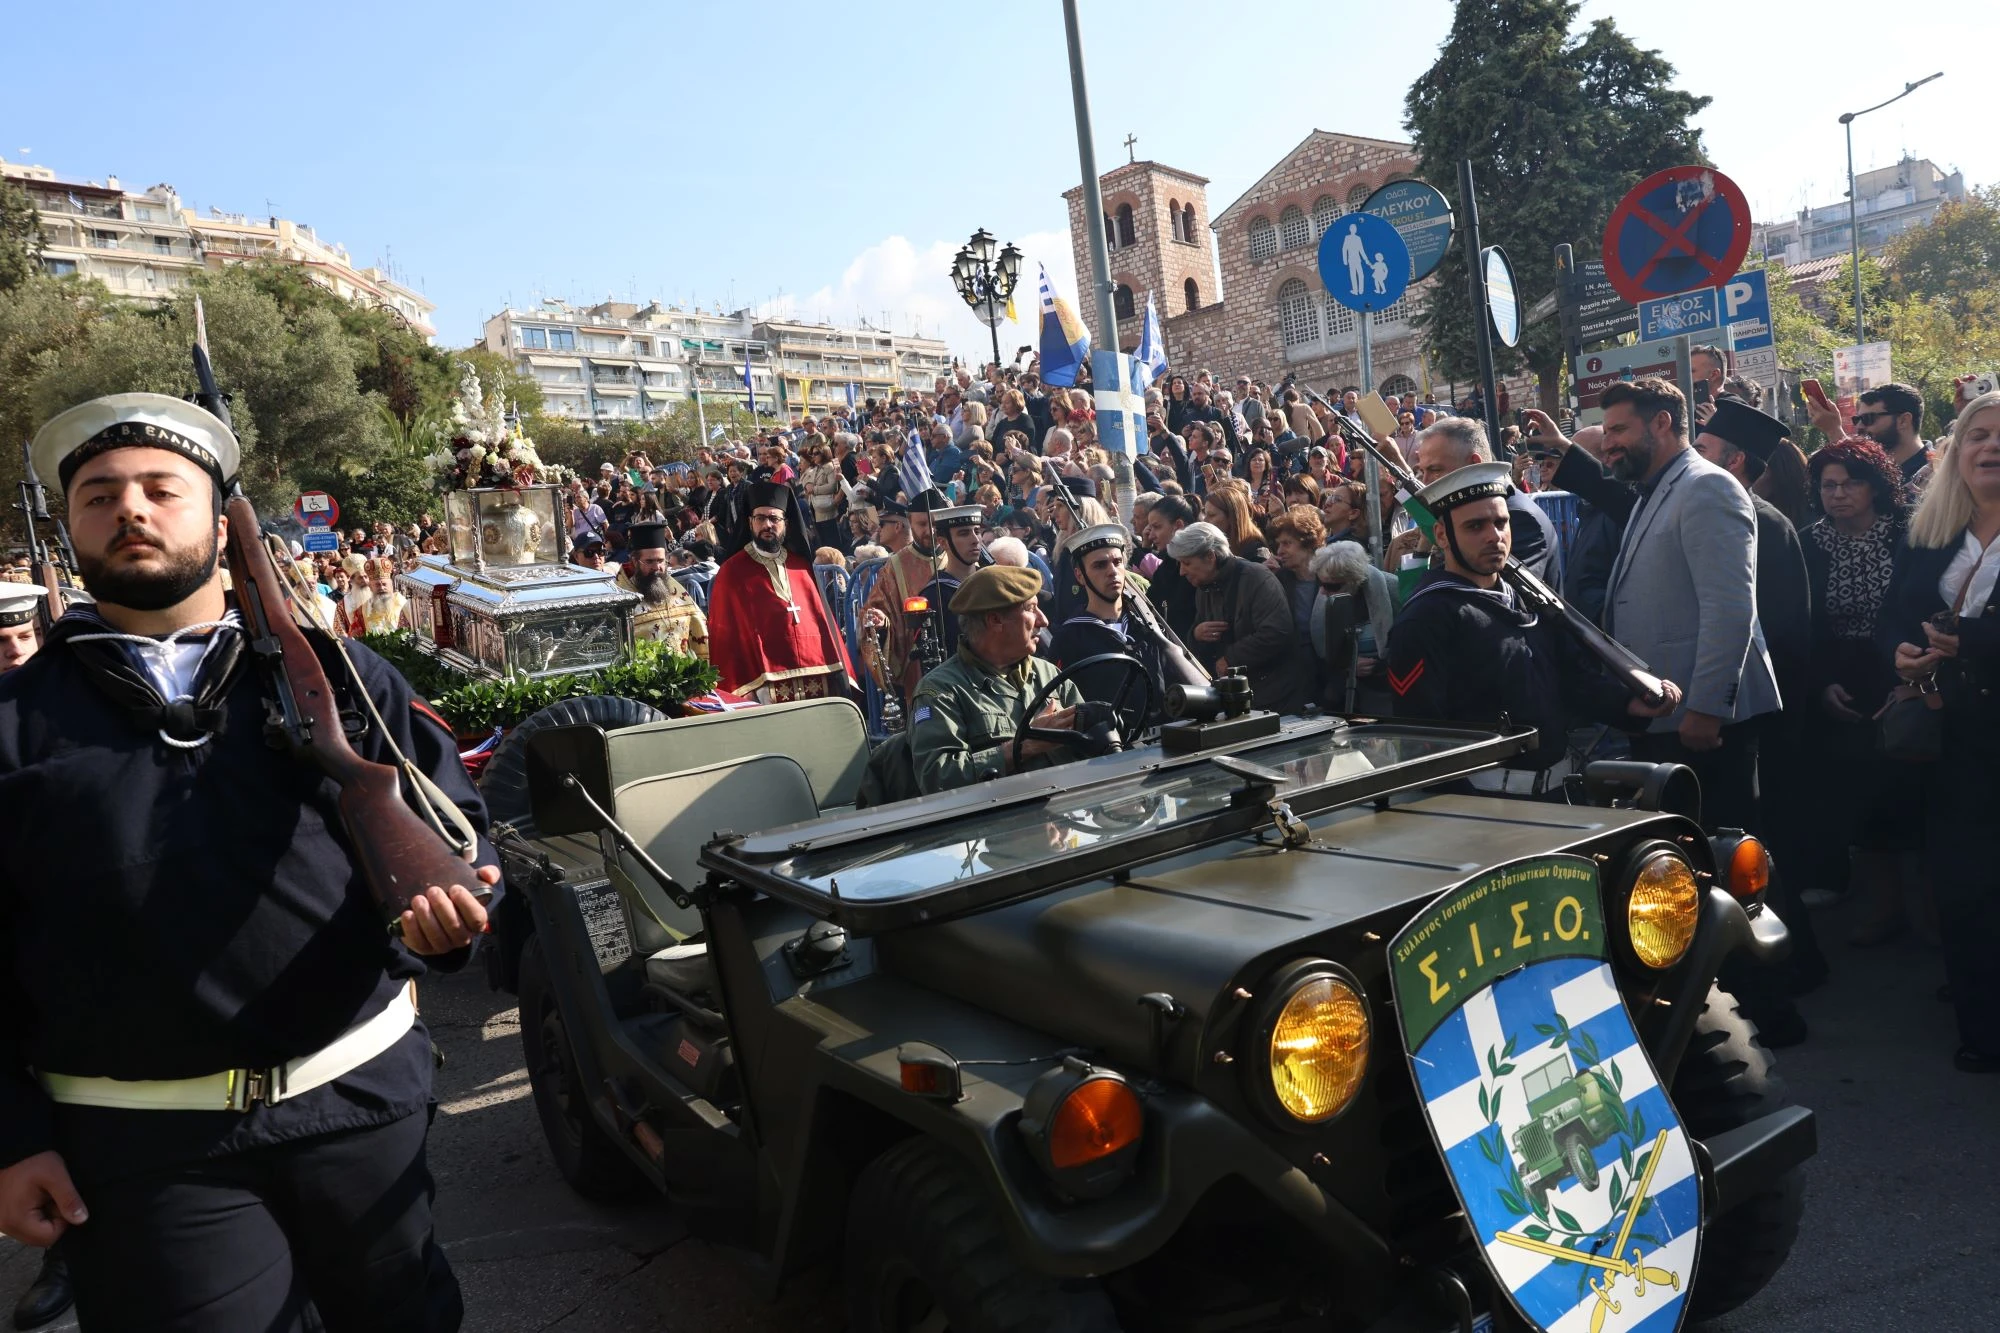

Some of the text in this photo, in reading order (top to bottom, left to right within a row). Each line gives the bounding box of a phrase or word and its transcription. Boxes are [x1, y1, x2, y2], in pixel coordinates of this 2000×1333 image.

[1366, 194, 1432, 218] ΕΛΕΥΚΟΥ
[1386, 188, 1408, 200] ΟΔΟΣ
[1725, 282, 1753, 317] P
[1397, 864, 1591, 962] Σύλλογος Ιστορικών Στρατιωτικών Οχημάτων
